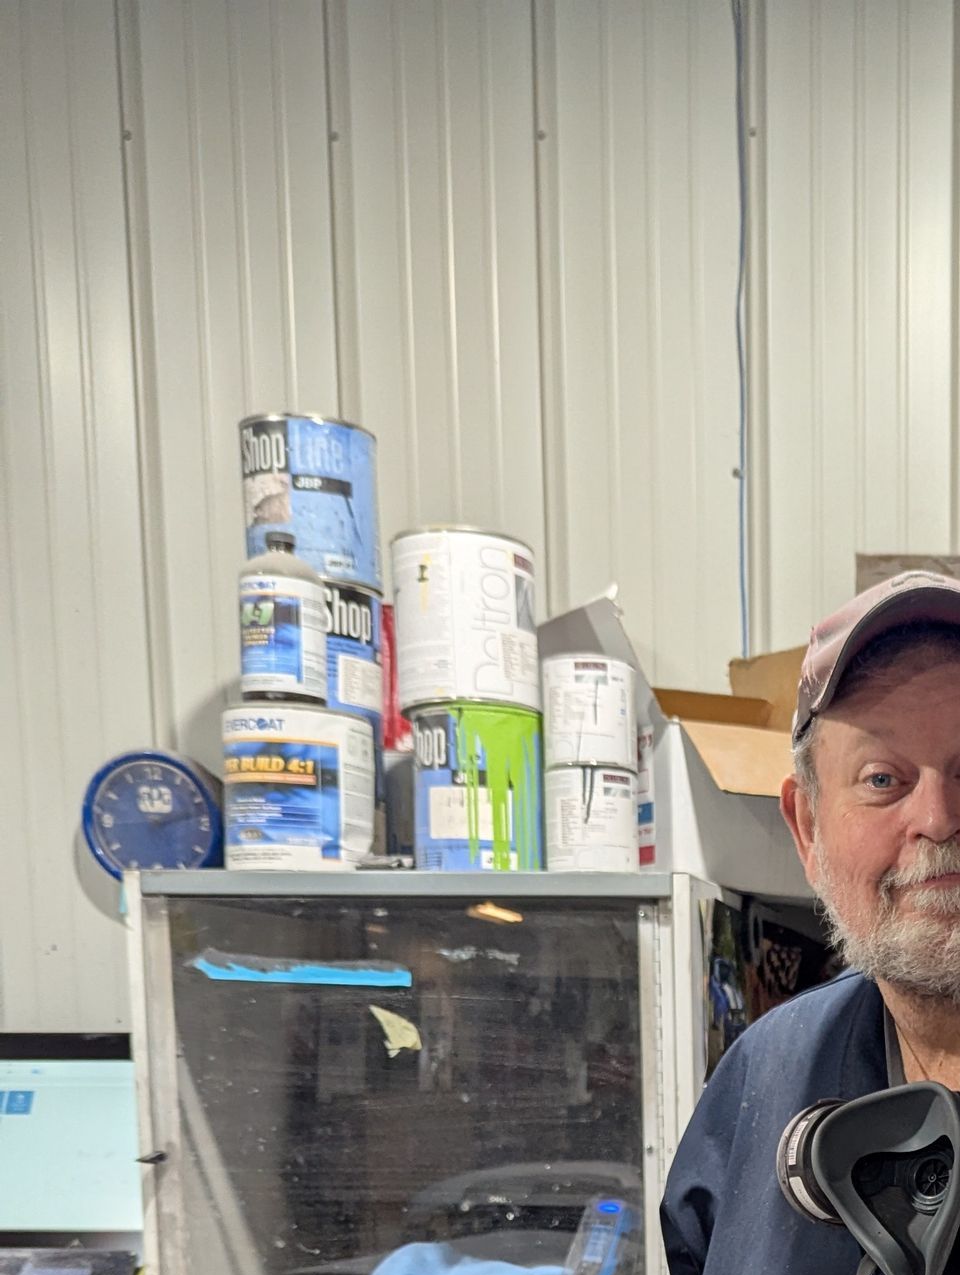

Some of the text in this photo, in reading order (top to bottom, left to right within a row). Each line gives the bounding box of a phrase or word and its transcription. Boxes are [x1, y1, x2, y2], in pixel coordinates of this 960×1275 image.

[243, 424, 344, 474] Shop Line
[322, 588, 371, 644] Shop
[240, 755, 285, 772] BUILD
